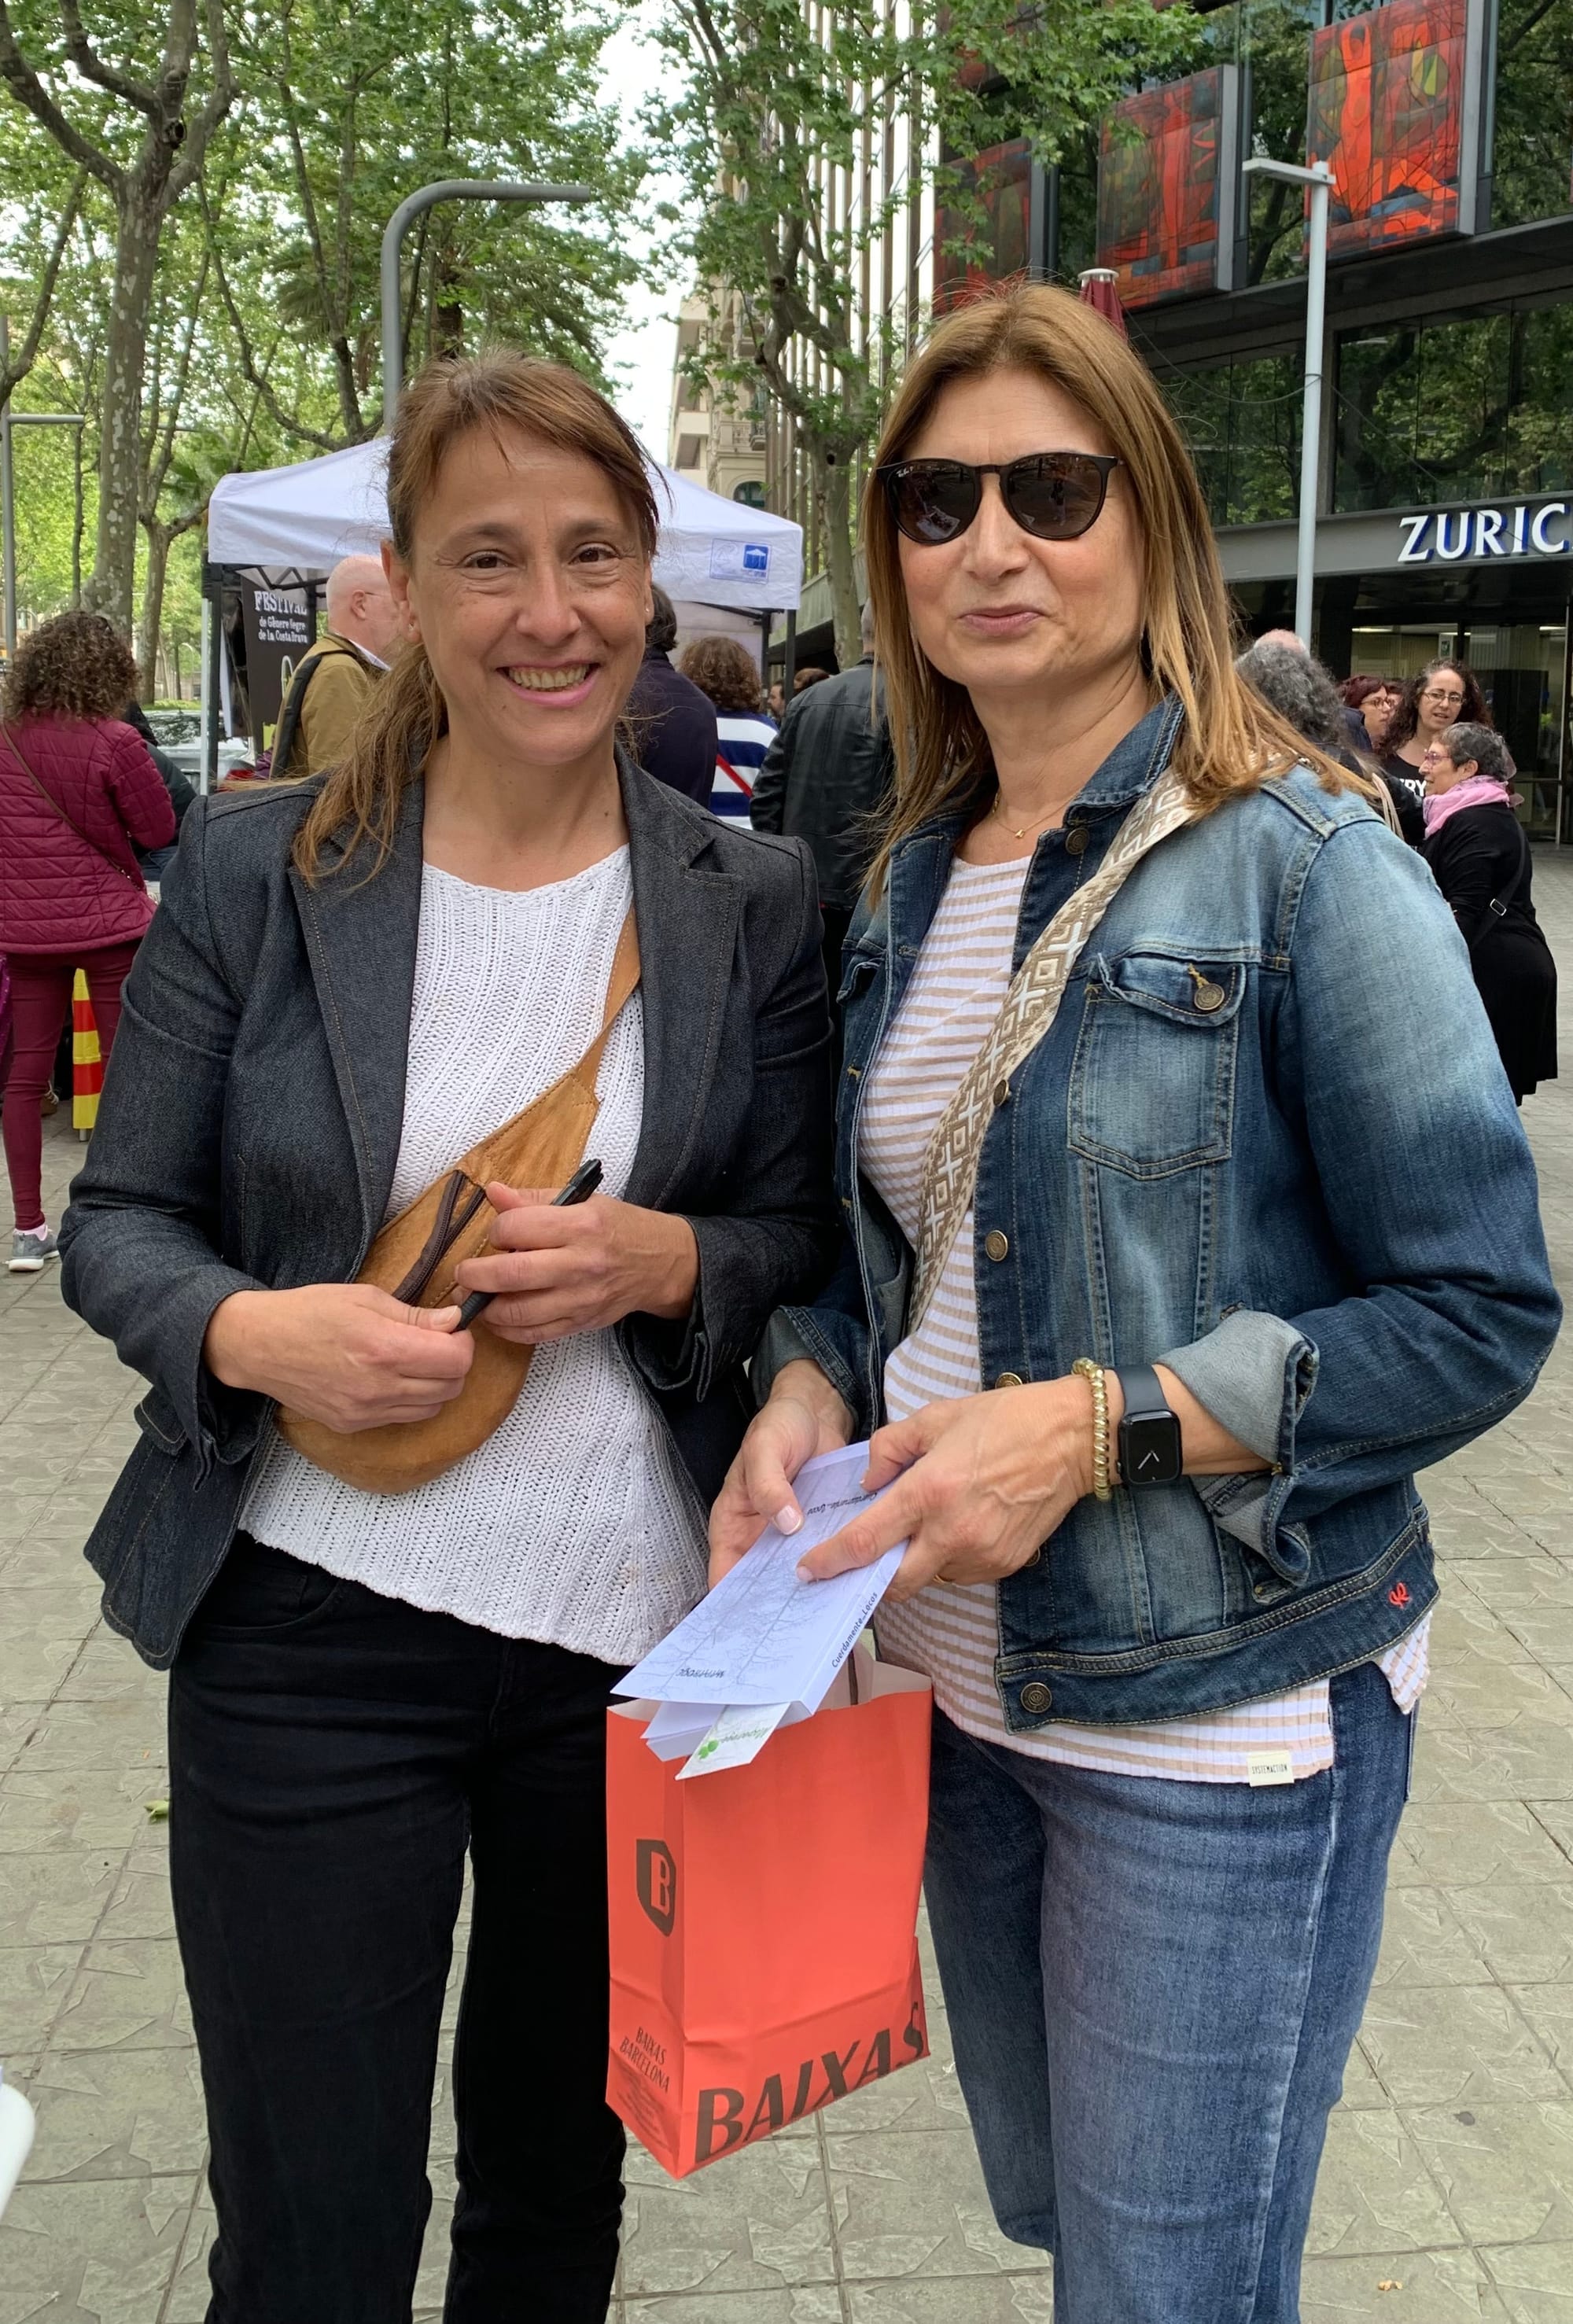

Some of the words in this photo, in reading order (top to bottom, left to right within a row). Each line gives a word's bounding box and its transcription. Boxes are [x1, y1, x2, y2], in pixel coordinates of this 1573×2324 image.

[1398, 503, 1573, 562] ZURIC
[254, 591, 308, 616] FESTIVAL
[258, 628, 267, 641] de
[267, 628, 275, 641] la
[259, 616, 267, 628] de
[1400, 779, 1427, 797] RY
[831, 1592, 878, 1668] Cuerdamente_Locos
[1251, 1763, 1288, 1775] SYSTEMACTION
[635, 2026, 667, 2065] BAIXAS
[619, 2035, 670, 2094] BARCELONA
[694, 2001, 924, 2163] BAIXAS
